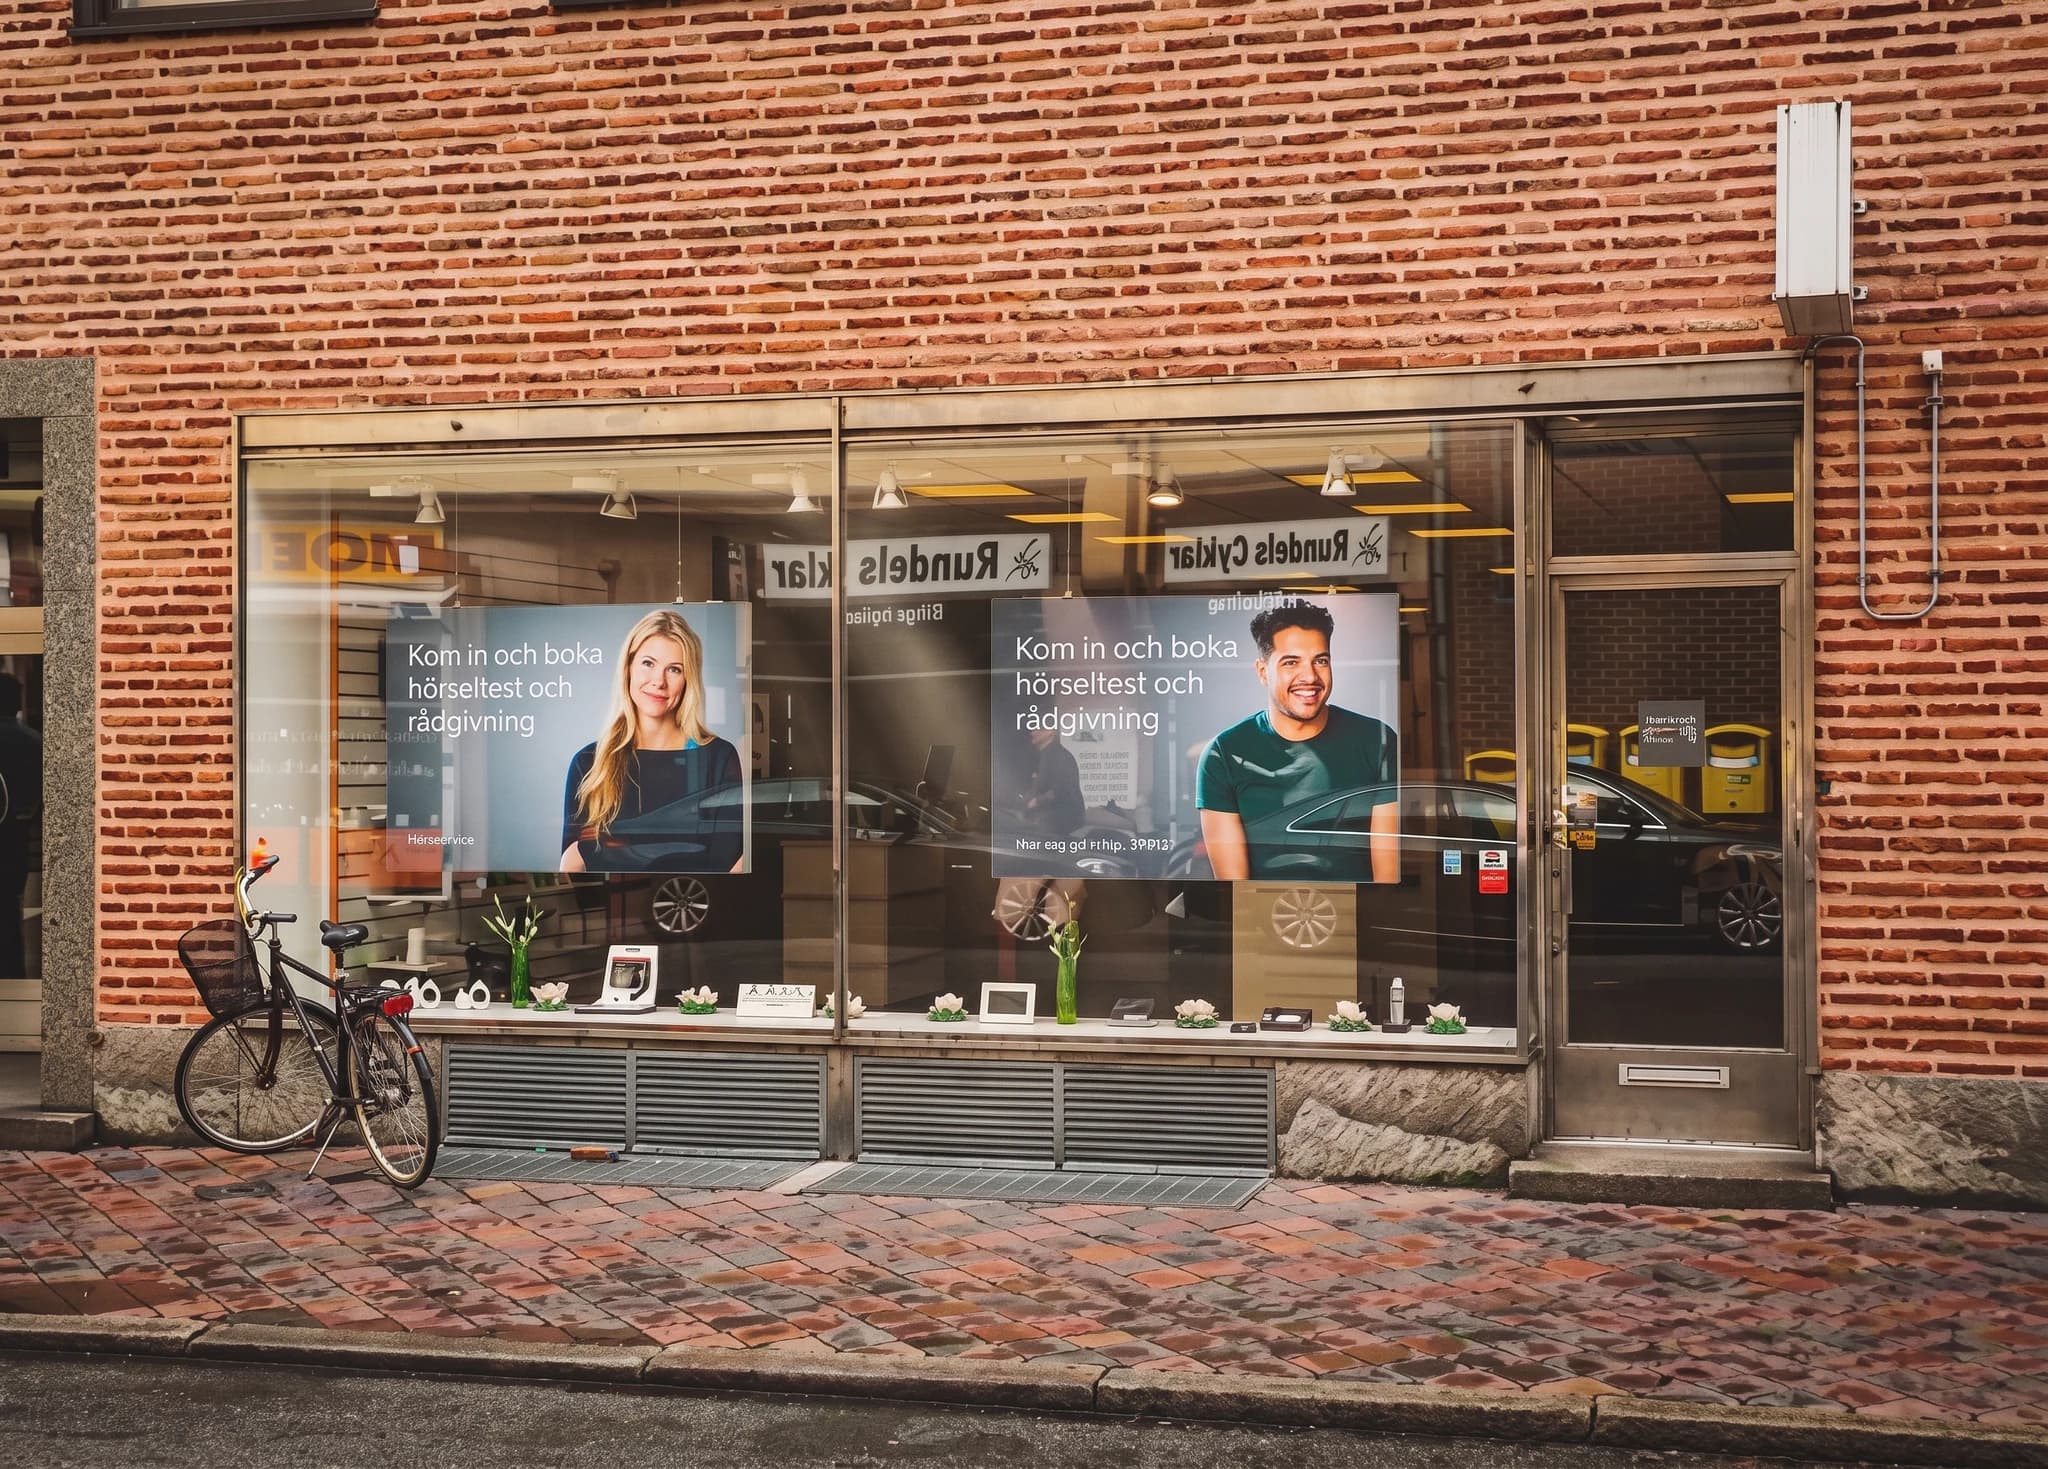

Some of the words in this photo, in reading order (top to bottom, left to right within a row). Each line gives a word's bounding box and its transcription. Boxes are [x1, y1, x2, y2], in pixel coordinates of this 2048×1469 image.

[408, 643, 461, 666] Kom
[468, 643, 487, 665] in
[494, 642, 537, 666] och
[544, 641, 603, 665] boka
[1016, 636, 1075, 661] Kom
[1083, 636, 1105, 660] in
[1113, 635, 1163, 660] och
[1171, 634, 1238, 659] boka
[408, 676, 523, 699] hörseltest
[529, 675, 572, 699] och
[1016, 671, 1147, 696] hörseltest
[1154, 671, 1204, 695] och
[408, 707, 536, 738] rådgivning
[1016, 705, 1160, 736] rådgivning
[1044, 841, 1066, 853] eag
[1069, 838, 1087, 853] gd
